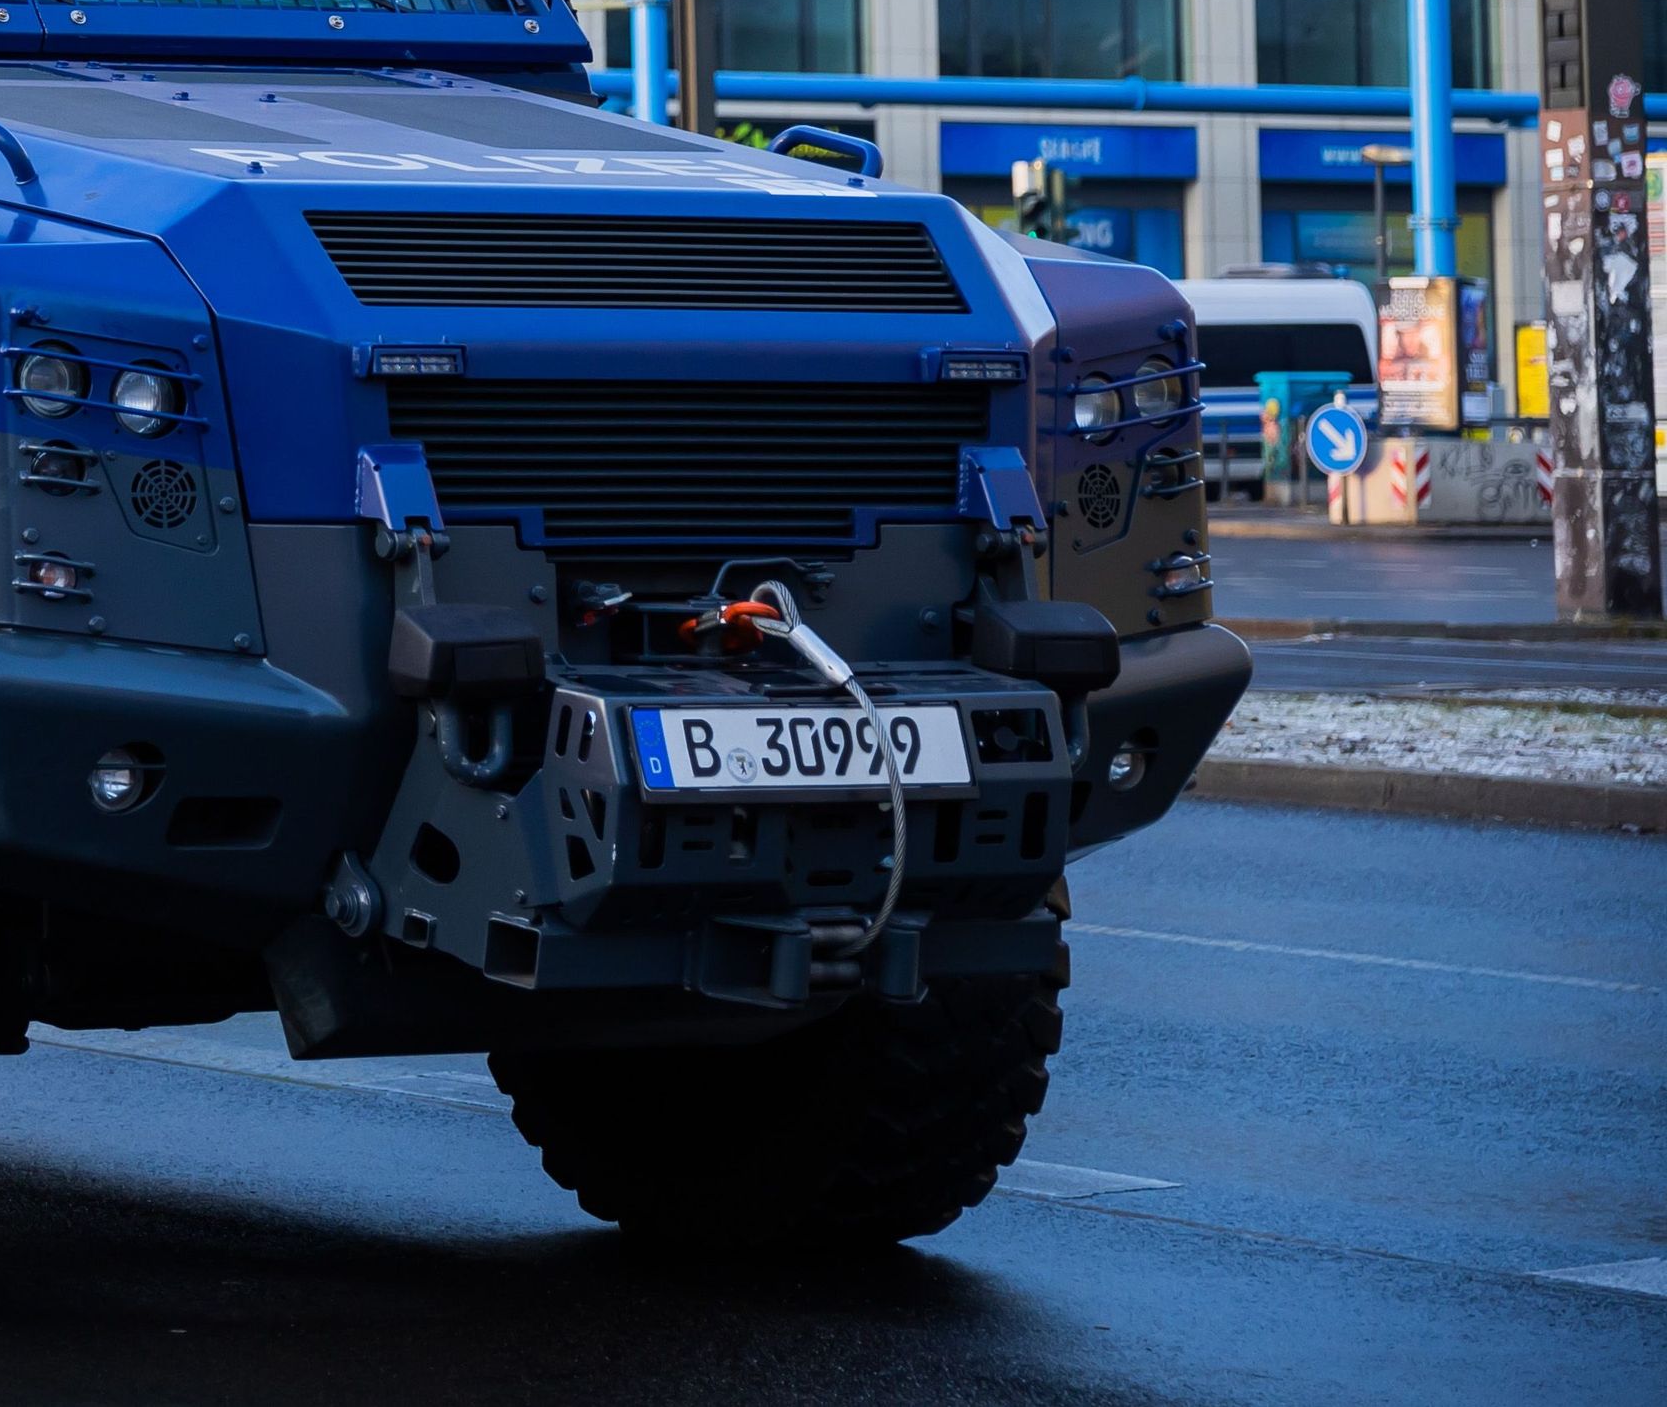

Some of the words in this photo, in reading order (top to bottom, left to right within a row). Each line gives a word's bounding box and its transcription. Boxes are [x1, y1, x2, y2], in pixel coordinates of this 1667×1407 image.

[189, 147, 801, 179] POLIZEI
[682, 718, 721, 777] B
[756, 715, 921, 776] 30999
[649, 757, 662, 774] D
